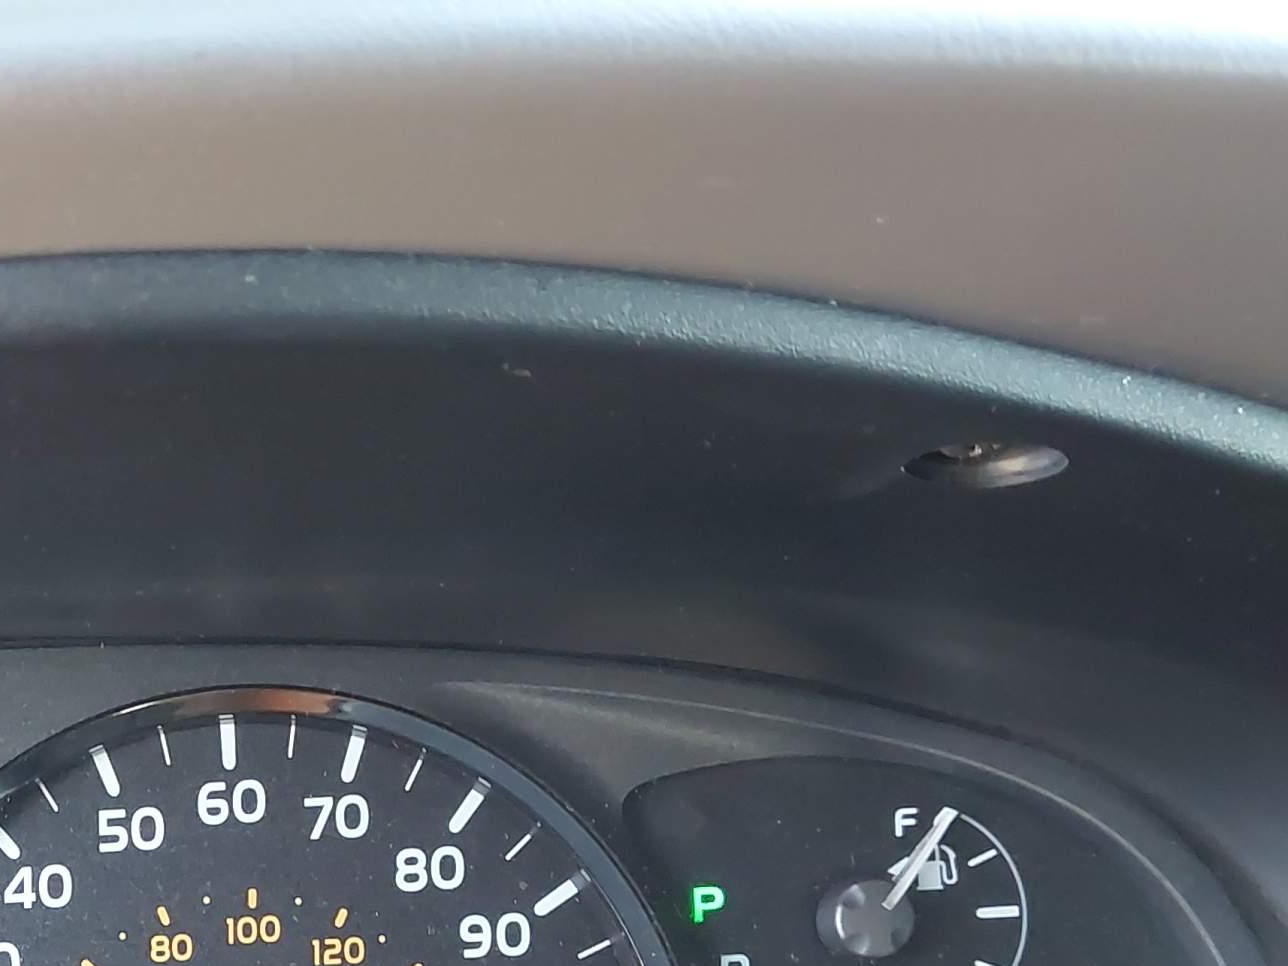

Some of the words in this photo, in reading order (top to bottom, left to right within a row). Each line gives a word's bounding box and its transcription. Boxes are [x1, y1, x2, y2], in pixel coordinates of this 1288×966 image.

[196, 778, 268, 826] 60
[303, 793, 371, 841] 70
[894, 807, 919, 838] F
[97, 806, 166, 853] 50
[3, 863, 73, 909] 40
[394, 845, 466, 892] 80
[692, 885, 725, 923] P
[149, 932, 194, 964] 80
[225, 914, 282, 946] 100
[311, 936, 366, 966] 120
[458, 911, 532, 959] 90
